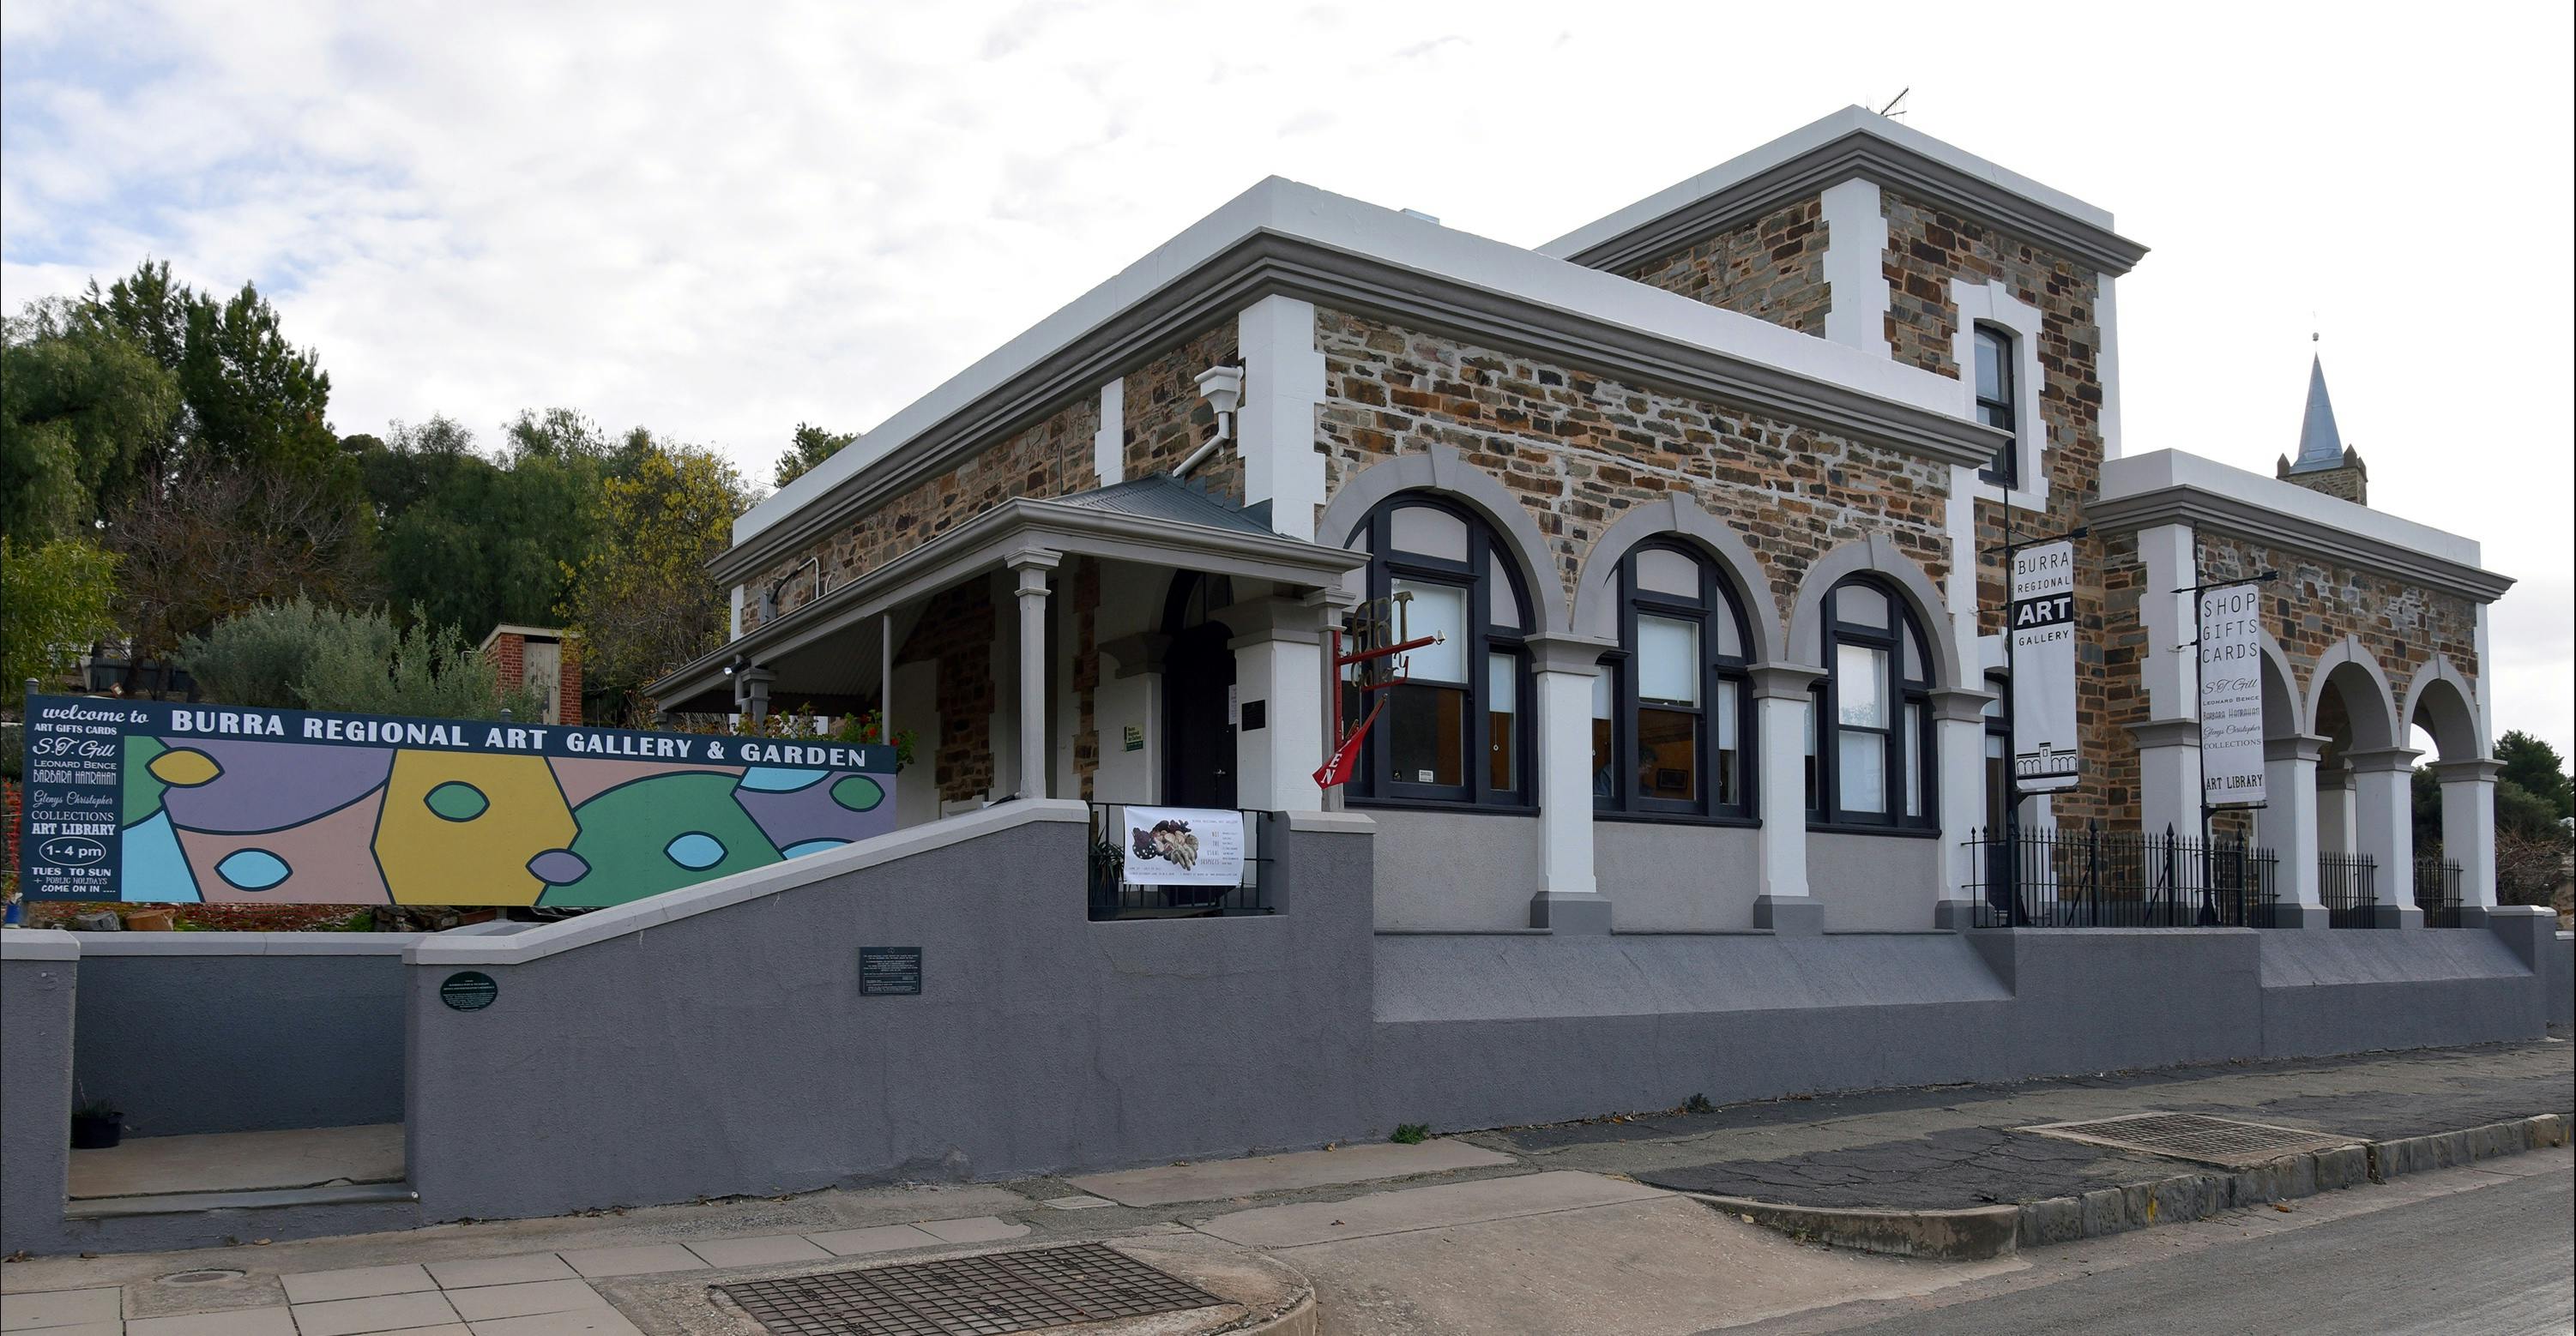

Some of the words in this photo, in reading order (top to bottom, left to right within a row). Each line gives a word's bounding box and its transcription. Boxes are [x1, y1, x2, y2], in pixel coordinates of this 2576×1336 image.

[2018, 551, 2069, 575] BURRA
[2018, 575, 2071, 593] REGIONAL
[2017, 597, 2072, 626] ART
[2204, 593, 2256, 617] SHOP
[2018, 629, 2069, 647] GALLERY
[2203, 619, 2257, 641] GIFTS
[2203, 642, 2258, 663] CARDS
[2232, 677, 2258, 691] Gill
[33, 723, 53, 732] ART
[56, 724, 83, 733] GIFTS
[85, 726, 118, 736] CARDS
[42, 704, 125, 723] welcome
[130, 710, 149, 724] to
[172, 710, 285, 736] BURRA
[303, 718, 469, 747] REGIONAL
[485, 727, 548, 749] ART
[566, 732, 691, 758] GALLERY
[707, 741, 725, 760] &
[740, 743, 866, 767] GARDEN
[79, 740, 115, 759] Gill
[2203, 738, 2262, 750] COLLECTIONS
[33, 770, 71, 783] BARBARA
[75, 771, 116, 785] HANRAHAN
[2206, 777, 2223, 790] ART
[2227, 773, 2263, 789] LIBRARY
[33, 789, 63, 808] Glenys
[66, 791, 113, 809] Christopher
[32, 810, 113, 821] COLLECTIONS
[32, 823, 57, 835] ART
[61, 823, 116, 835] LIBRARY
[79, 848, 102, 858] pm
[32, 867, 62, 876] TUES
[69, 868, 84, 876] TO
